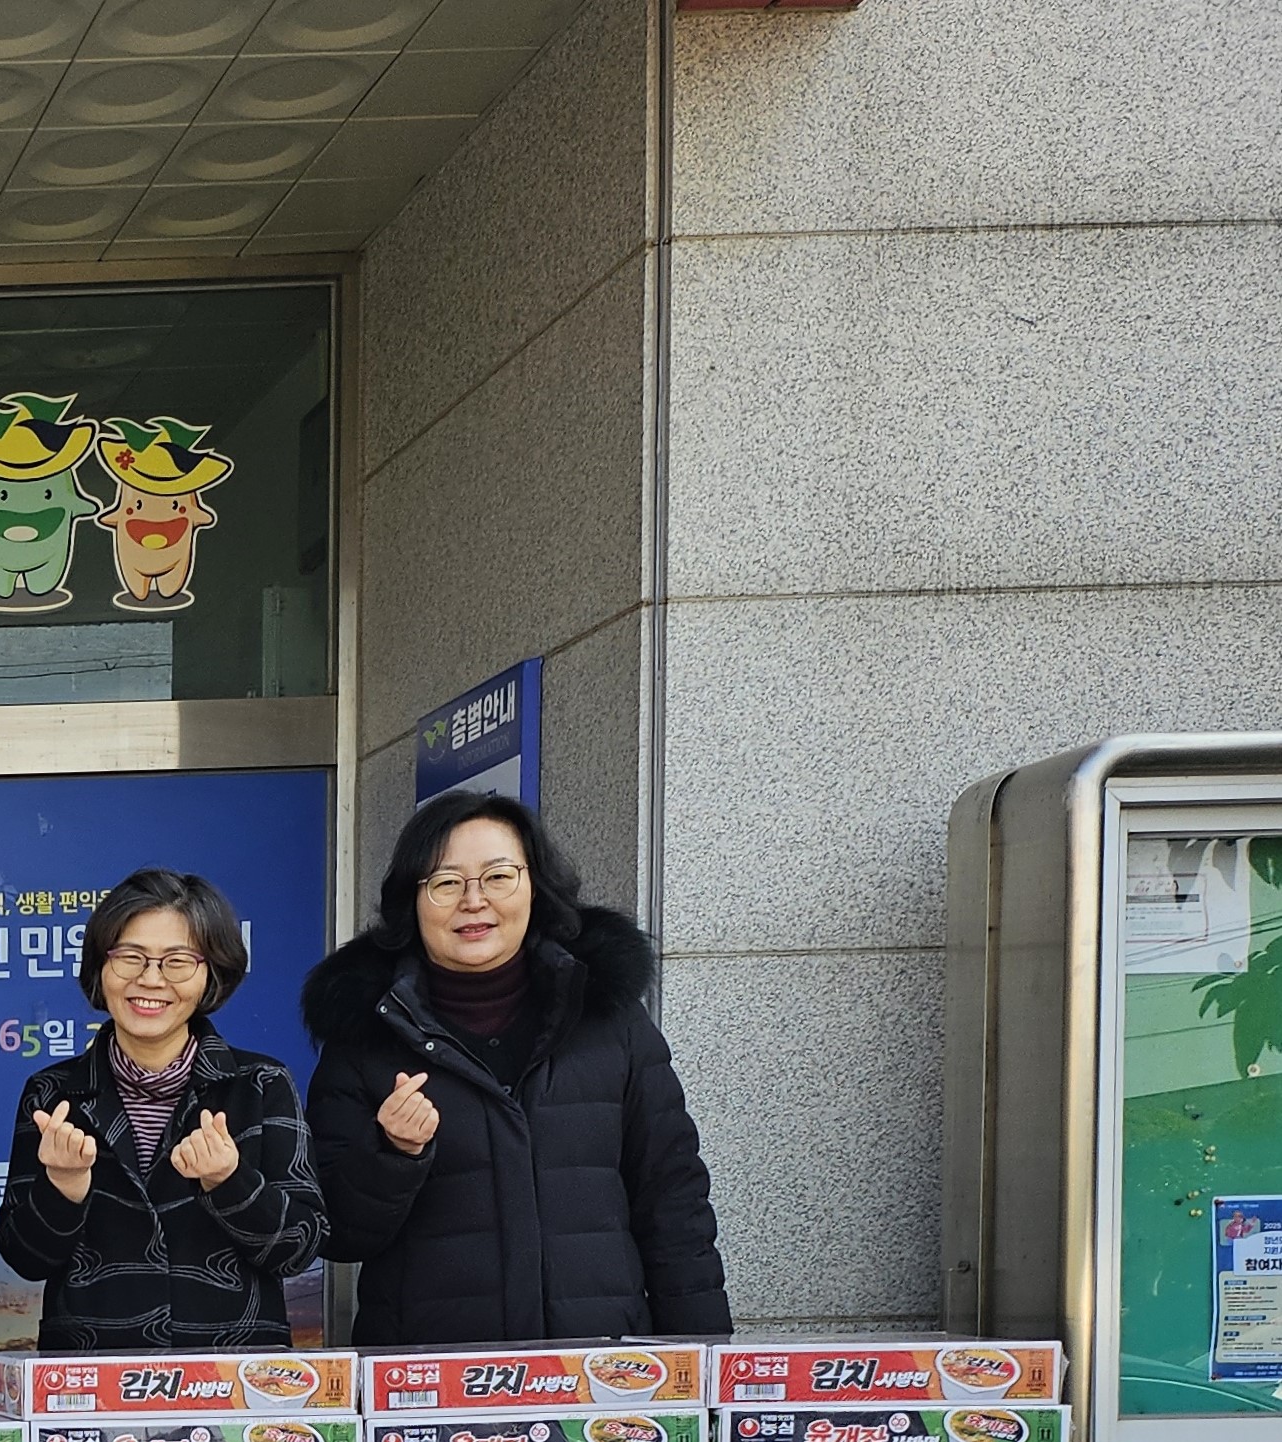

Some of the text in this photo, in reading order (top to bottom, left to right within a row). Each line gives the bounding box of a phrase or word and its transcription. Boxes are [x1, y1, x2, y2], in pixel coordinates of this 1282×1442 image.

[451, 680, 516, 751] 층별안내
[16, 890, 55, 915] 생활
[65, 1368, 235, 1401] 농심 김치 사발면
[407, 1364, 580, 1397] 농심 김치 사발면
[754, 1358, 930, 1391] 농심 김치 사발면
[761, 1419, 795, 1436] 농심
